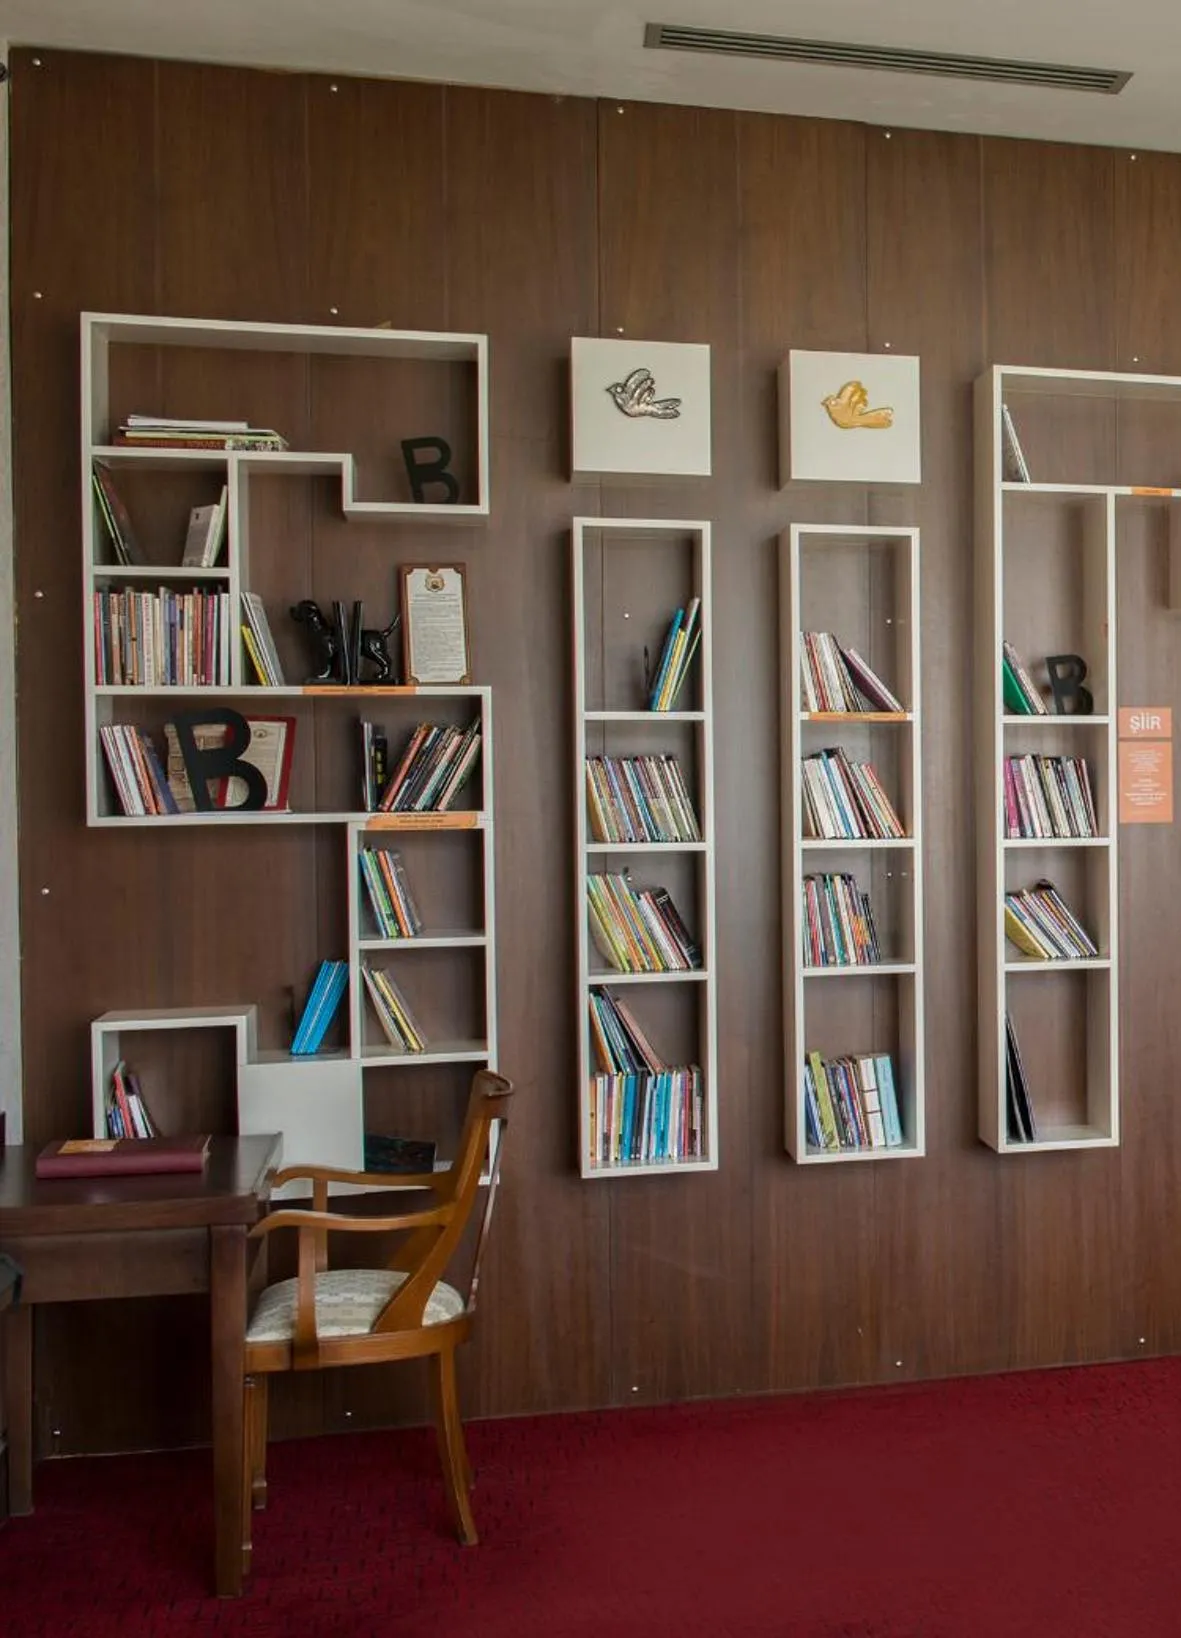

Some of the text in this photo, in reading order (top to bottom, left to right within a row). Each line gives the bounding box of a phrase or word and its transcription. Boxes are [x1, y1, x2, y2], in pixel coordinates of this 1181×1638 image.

[402, 437, 460, 503] B
[1045, 655, 1094, 715] B
[173, 708, 267, 811] B
